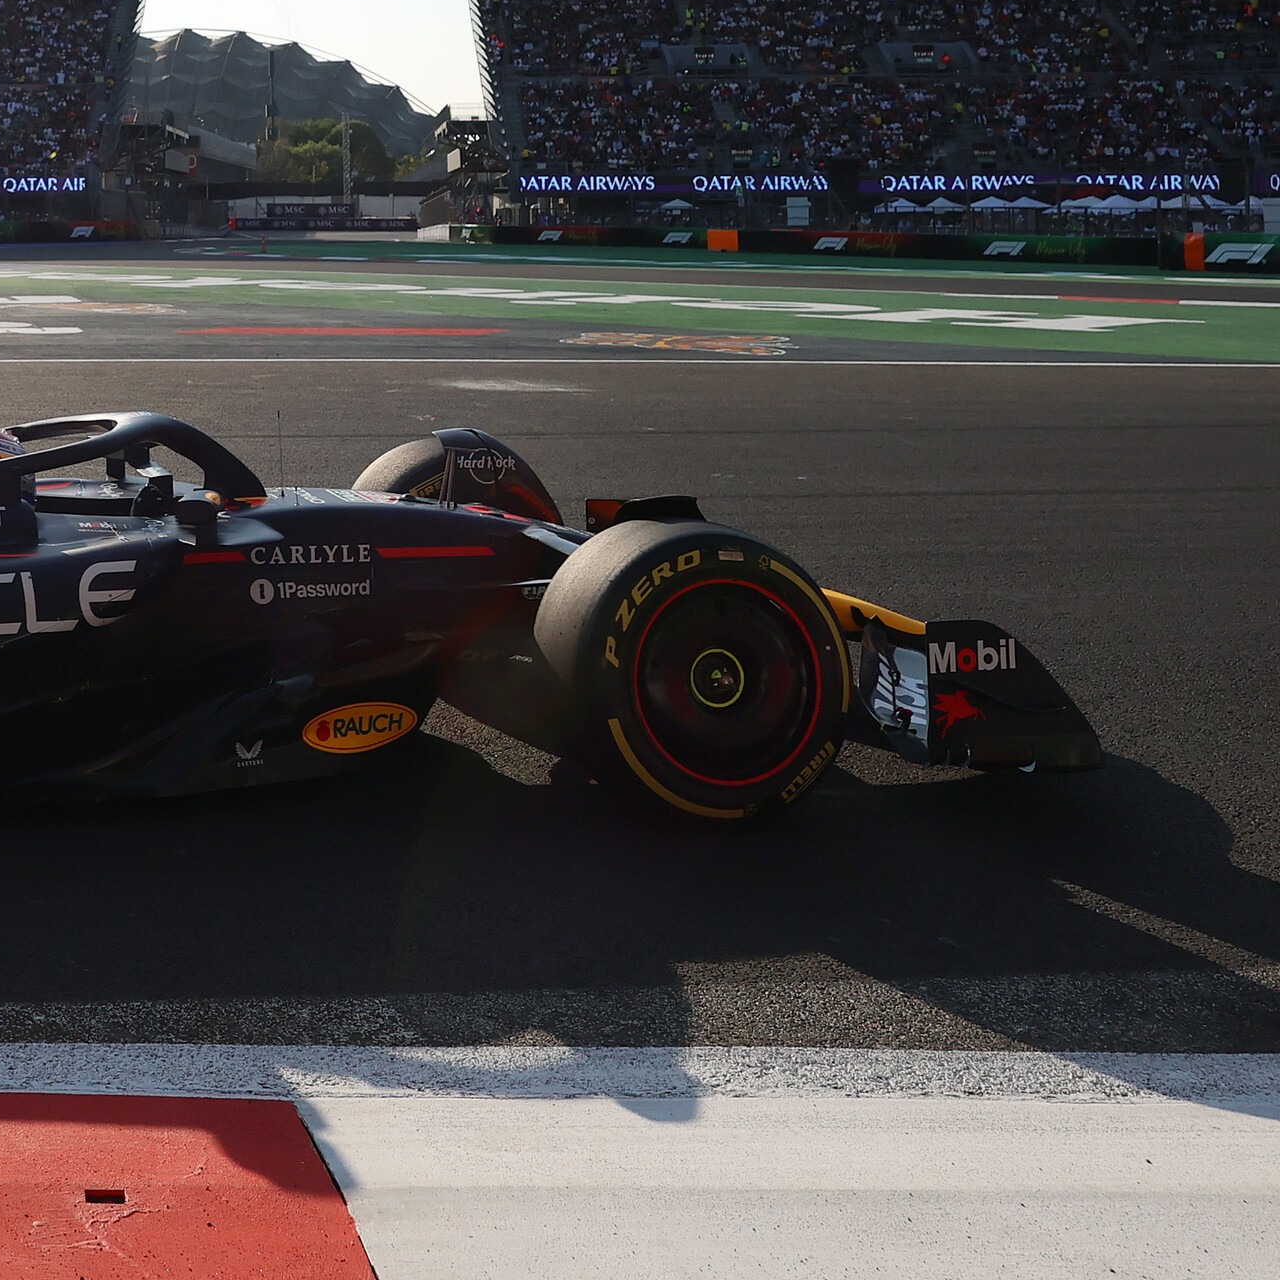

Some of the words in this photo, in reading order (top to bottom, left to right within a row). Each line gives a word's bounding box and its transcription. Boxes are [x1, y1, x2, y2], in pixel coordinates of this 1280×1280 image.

[3, 177, 57, 193] QATAR
[577, 175, 655, 191] AIRWAYS
[880, 175, 946, 192] QATAR
[285, 206, 306, 214] MSC
[328, 206, 350, 214] MSC
[983, 241, 1028, 256] F1
[1204, 243, 1276, 265] F1
[249, 543, 371, 565] CARLYLE
[277, 579, 371, 599] 1Password
[615, 549, 703, 632] ZERO
[928, 638, 1017, 675] Mobil
[333, 712, 403, 739] RAUCH
[780, 739, 838, 804] PIRELLI
